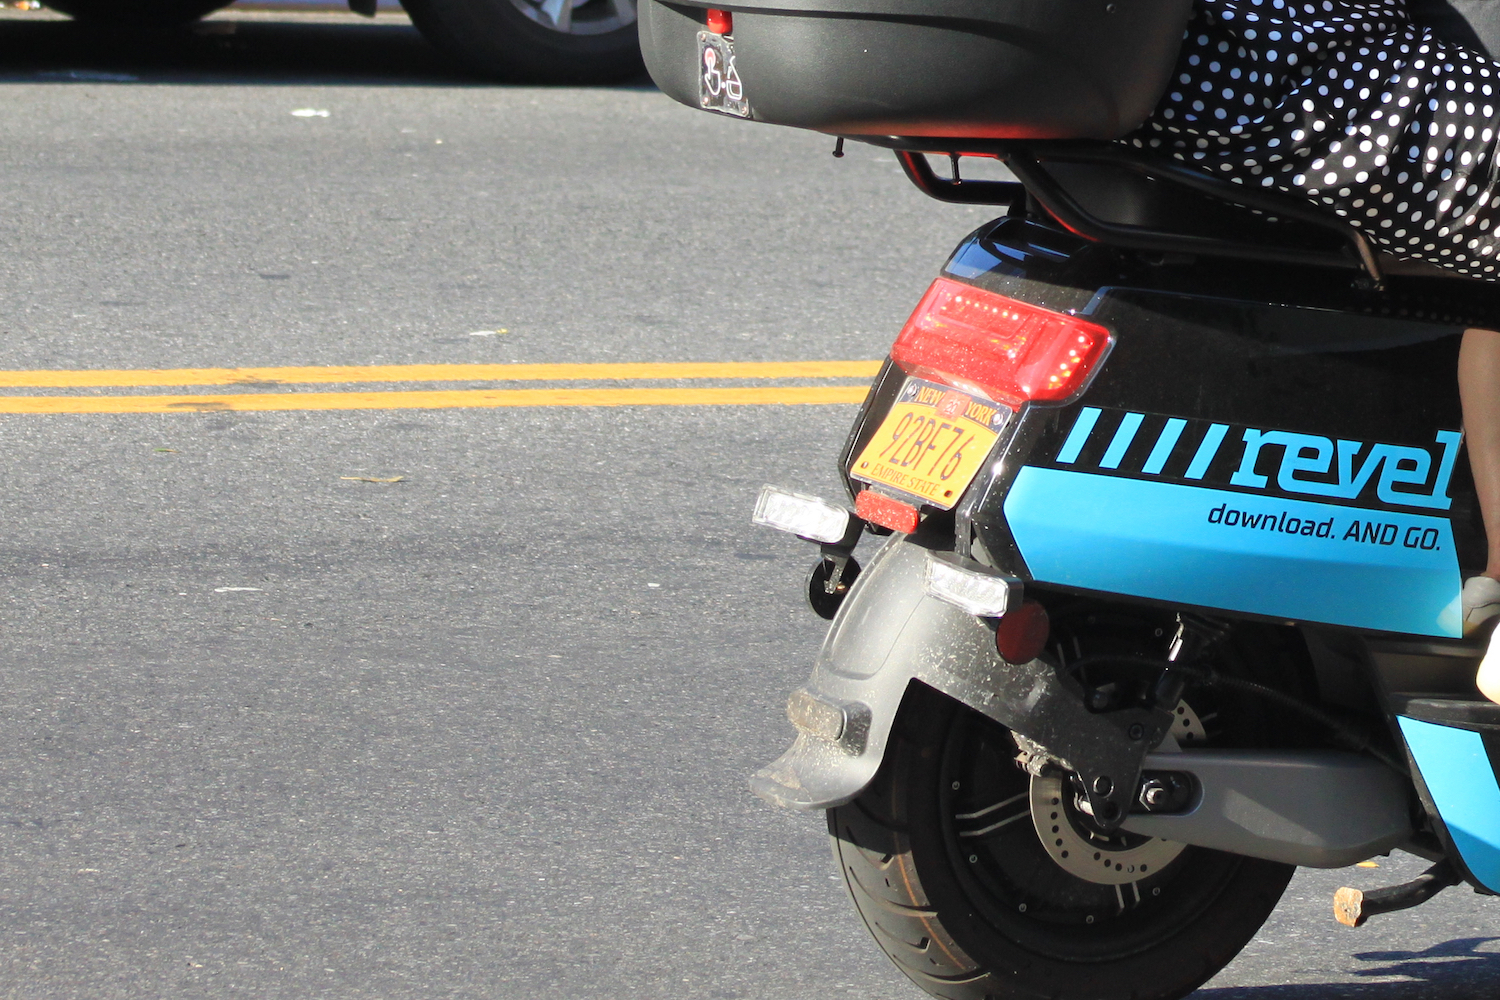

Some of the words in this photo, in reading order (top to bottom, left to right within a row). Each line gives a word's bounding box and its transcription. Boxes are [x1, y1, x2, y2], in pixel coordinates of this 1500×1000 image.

[914, 386, 946, 408] NEW
[965, 400, 998, 427] YORK
[878, 411, 976, 481] 92BF76
[1230, 428, 1463, 511] revel
[871, 463, 909, 486] EMPIRE
[907, 475, 941, 497] STATE
[1207, 503, 1336, 540] download.
[1342, 520, 1399, 546] AND
[1403, 526, 1441, 551] GO.
